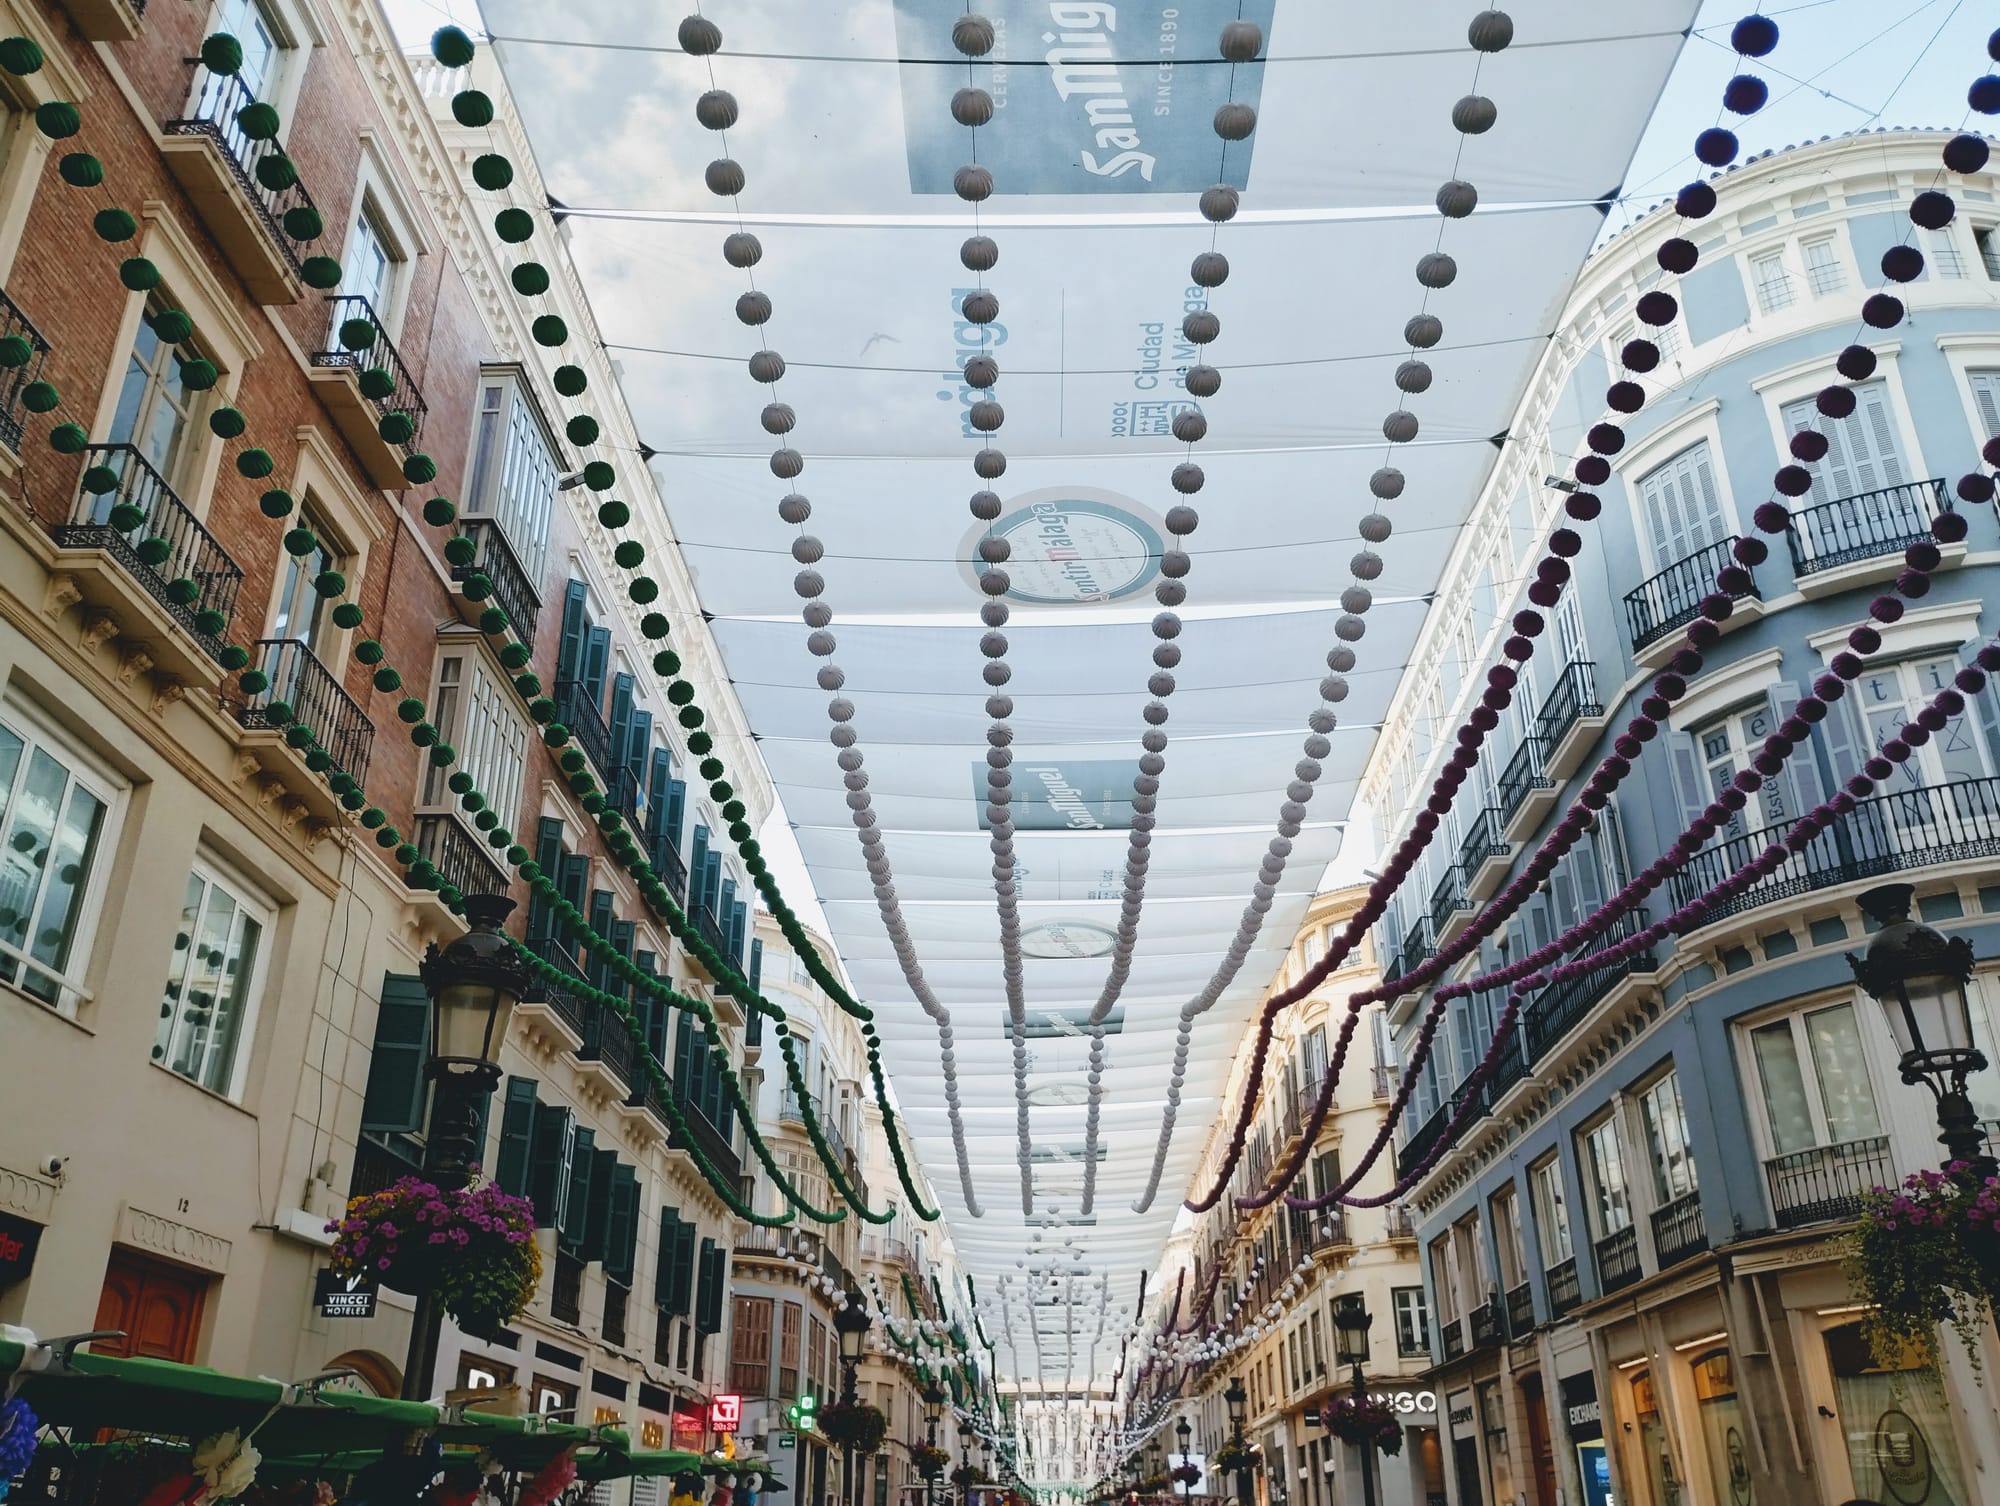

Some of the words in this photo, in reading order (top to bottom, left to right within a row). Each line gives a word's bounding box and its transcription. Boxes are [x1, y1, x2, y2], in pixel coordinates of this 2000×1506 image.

[1160, 8, 1180, 54] 1890
[1154, 61, 1174, 116] SINCE
[1134, 322, 1165, 390] Ciudad
[177, 1197, 190, 1213] 12
[326, 1306, 366, 1316] HOTELES
[328, 1295, 368, 1305] VINCCI
